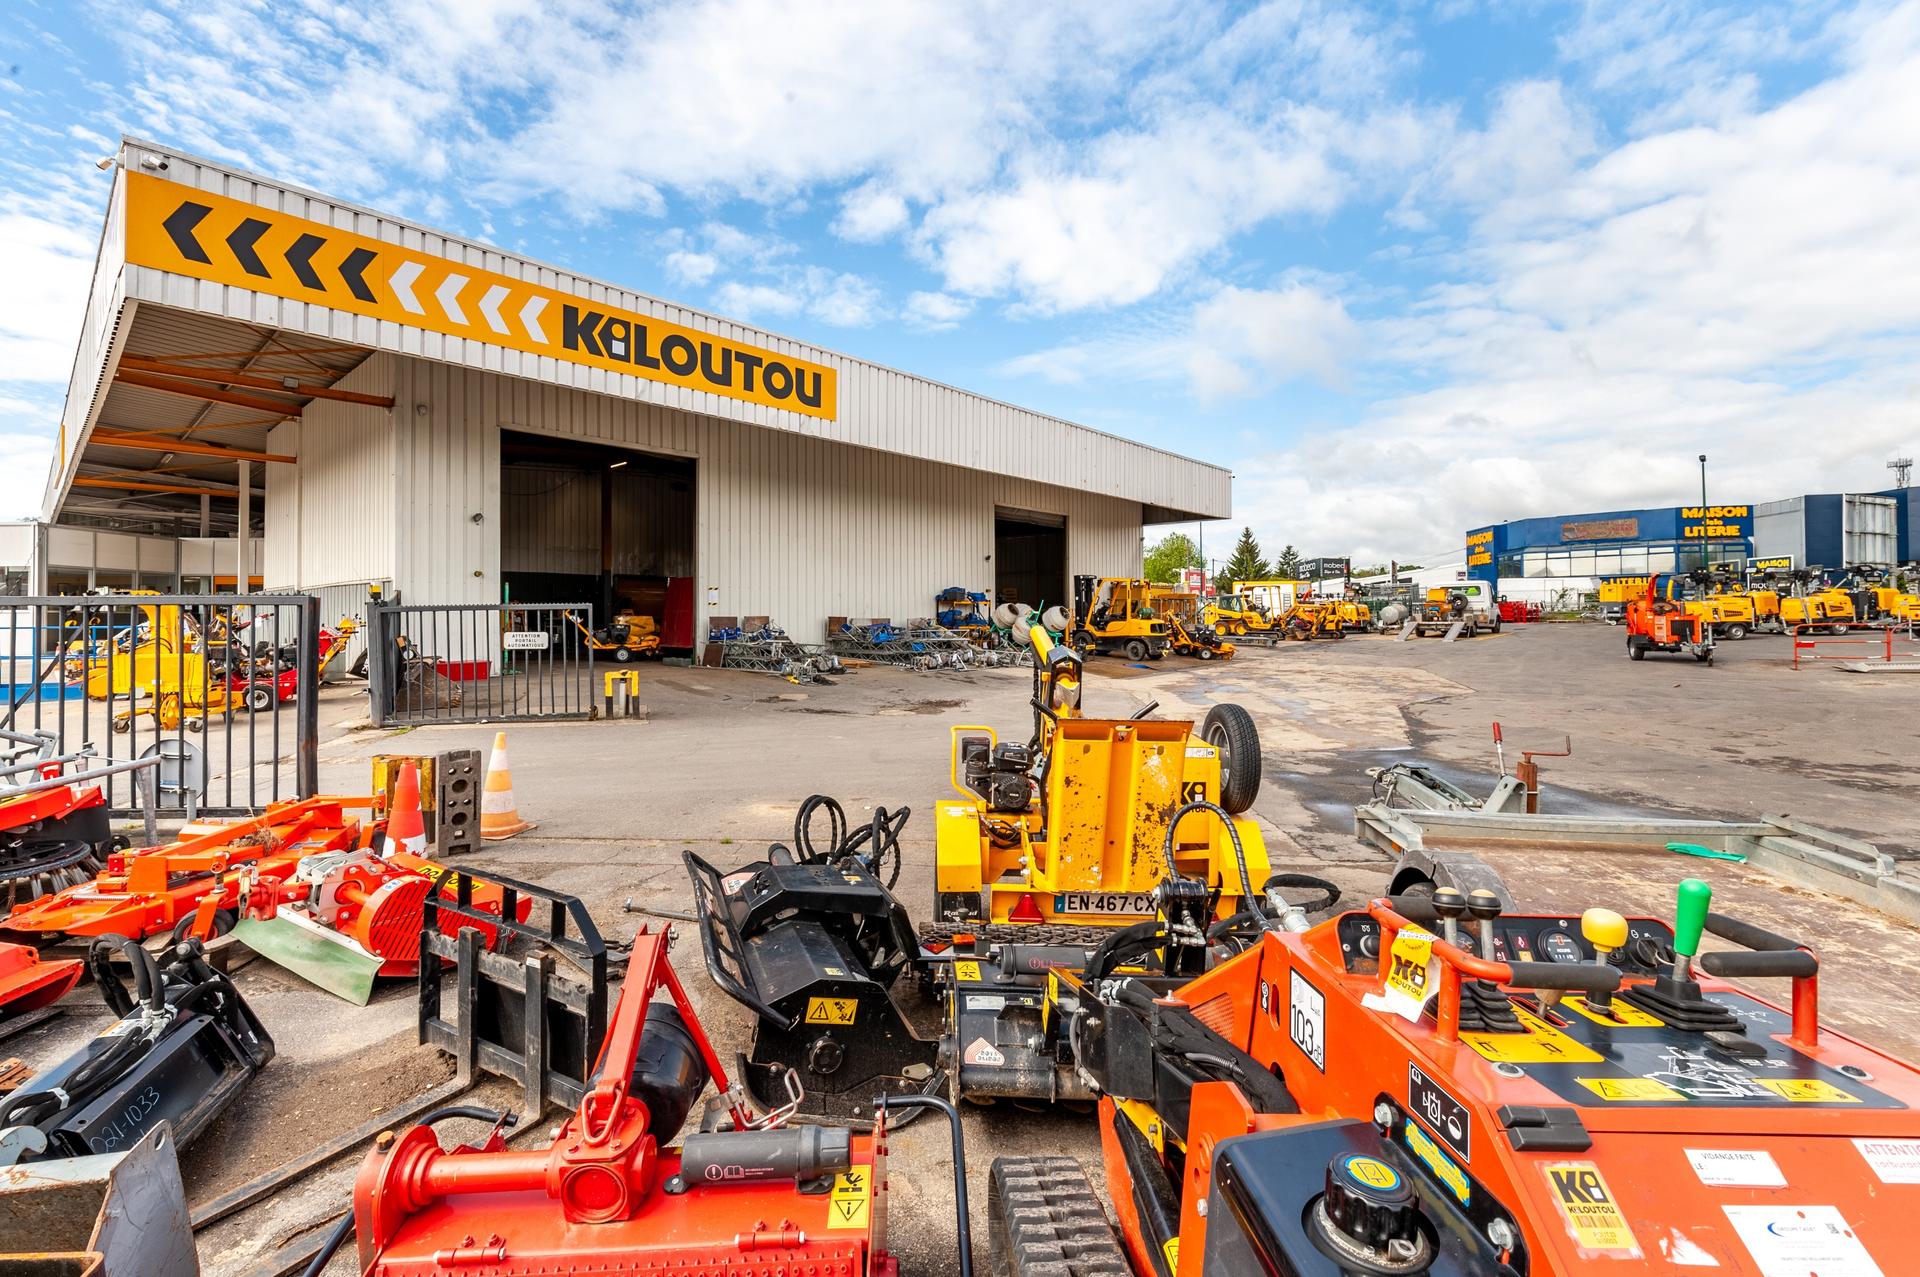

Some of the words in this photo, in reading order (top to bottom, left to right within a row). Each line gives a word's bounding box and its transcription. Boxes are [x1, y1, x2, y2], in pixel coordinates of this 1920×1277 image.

[1682, 507, 1748, 518] MAISON
[1685, 525, 1740, 537] LITERIE
[1756, 559, 1790, 568] MAISON
[1610, 577, 1651, 585] LITERI
[1292, 1004, 1314, 1056] 103
[1735, 1153, 1756, 1161] FAITE
